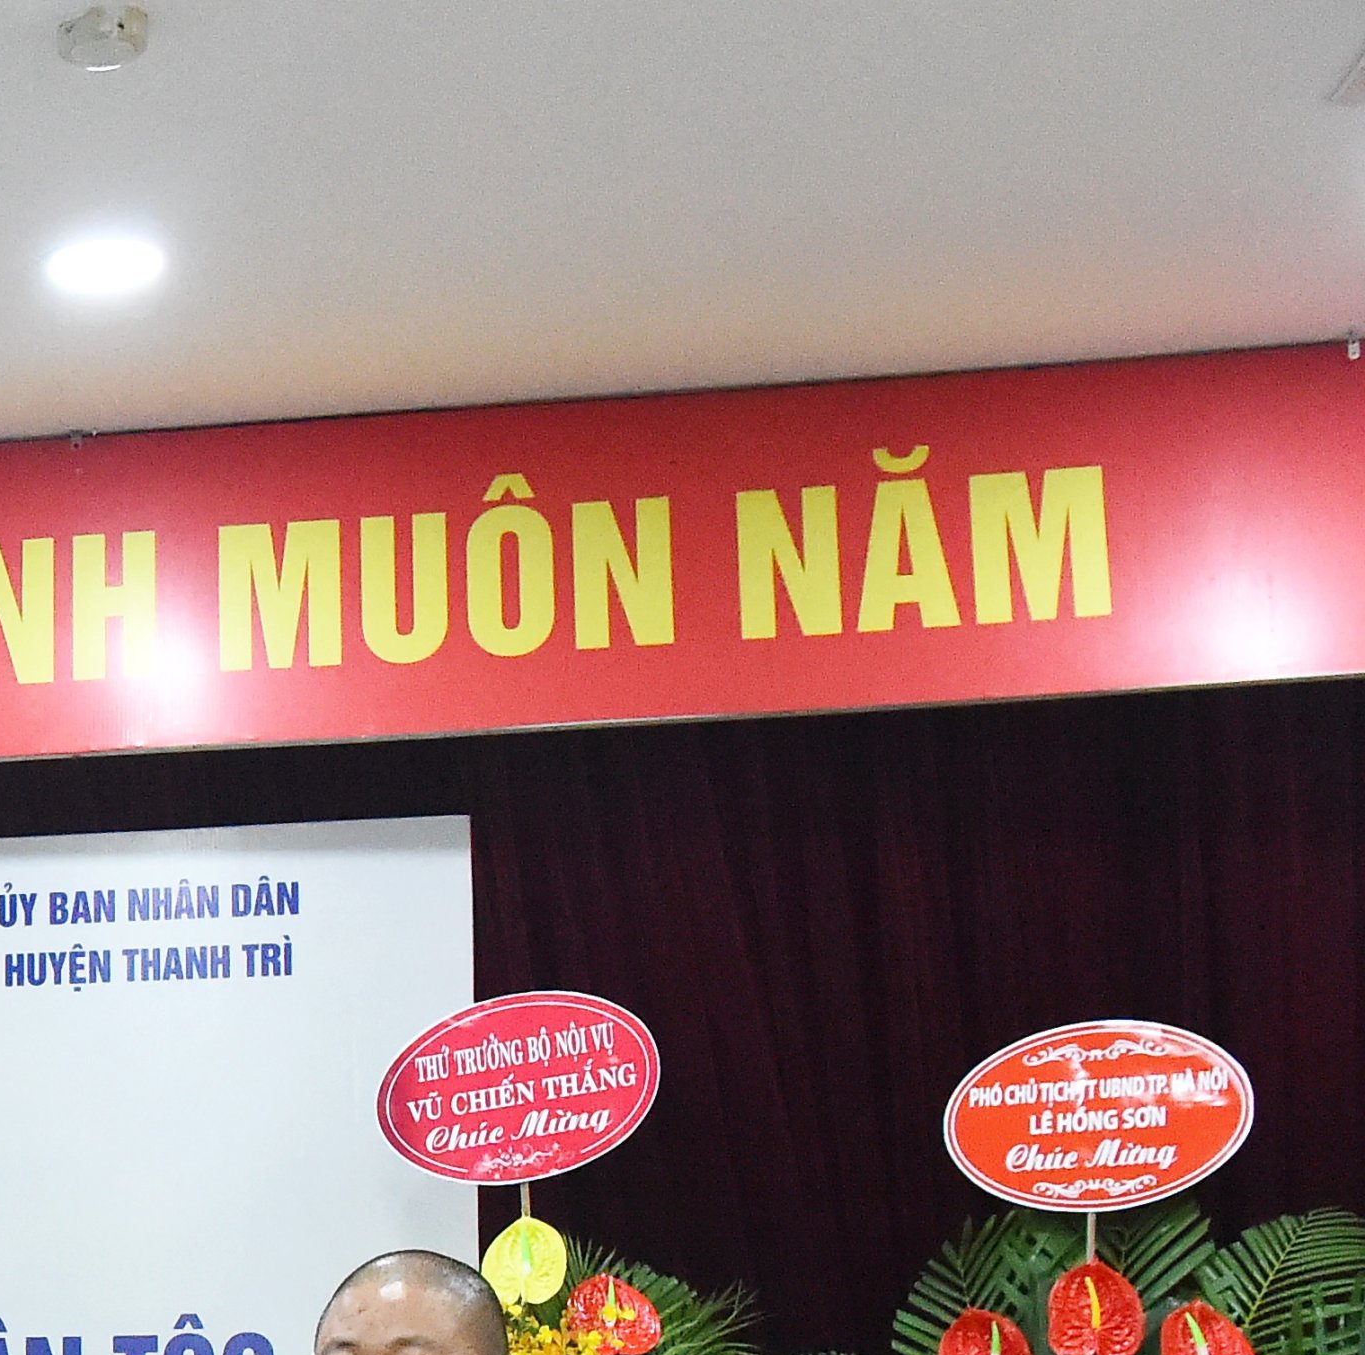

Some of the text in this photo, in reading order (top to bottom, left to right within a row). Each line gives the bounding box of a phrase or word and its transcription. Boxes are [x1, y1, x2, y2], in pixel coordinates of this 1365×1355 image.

[218, 473, 675, 673] MUÔN
[736, 446, 1113, 639] NĂM
[49, 889, 116, 926] BAN
[128, 881, 220, 922] NHÂN
[232, 876, 300, 918] DÂN
[5, 935, 293, 992] HUYỆN THANH TRÌ
[415, 1021, 615, 1083] THỨ TRƯỞNG BỘ NỘI VỤ
[407, 1058, 637, 1123] VŨ CHIẾN THẮNG
[969, 1066, 1229, 1108] PHÓ CHỦ TỊCH TT UBND TP. HÀ NỘI
[425, 1108, 614, 1155] Chúc Mừng
[1029, 1105, 1167, 1135] LÊ HỒNG SƠN
[1005, 1139, 1177, 1172] Chúc Mừng
